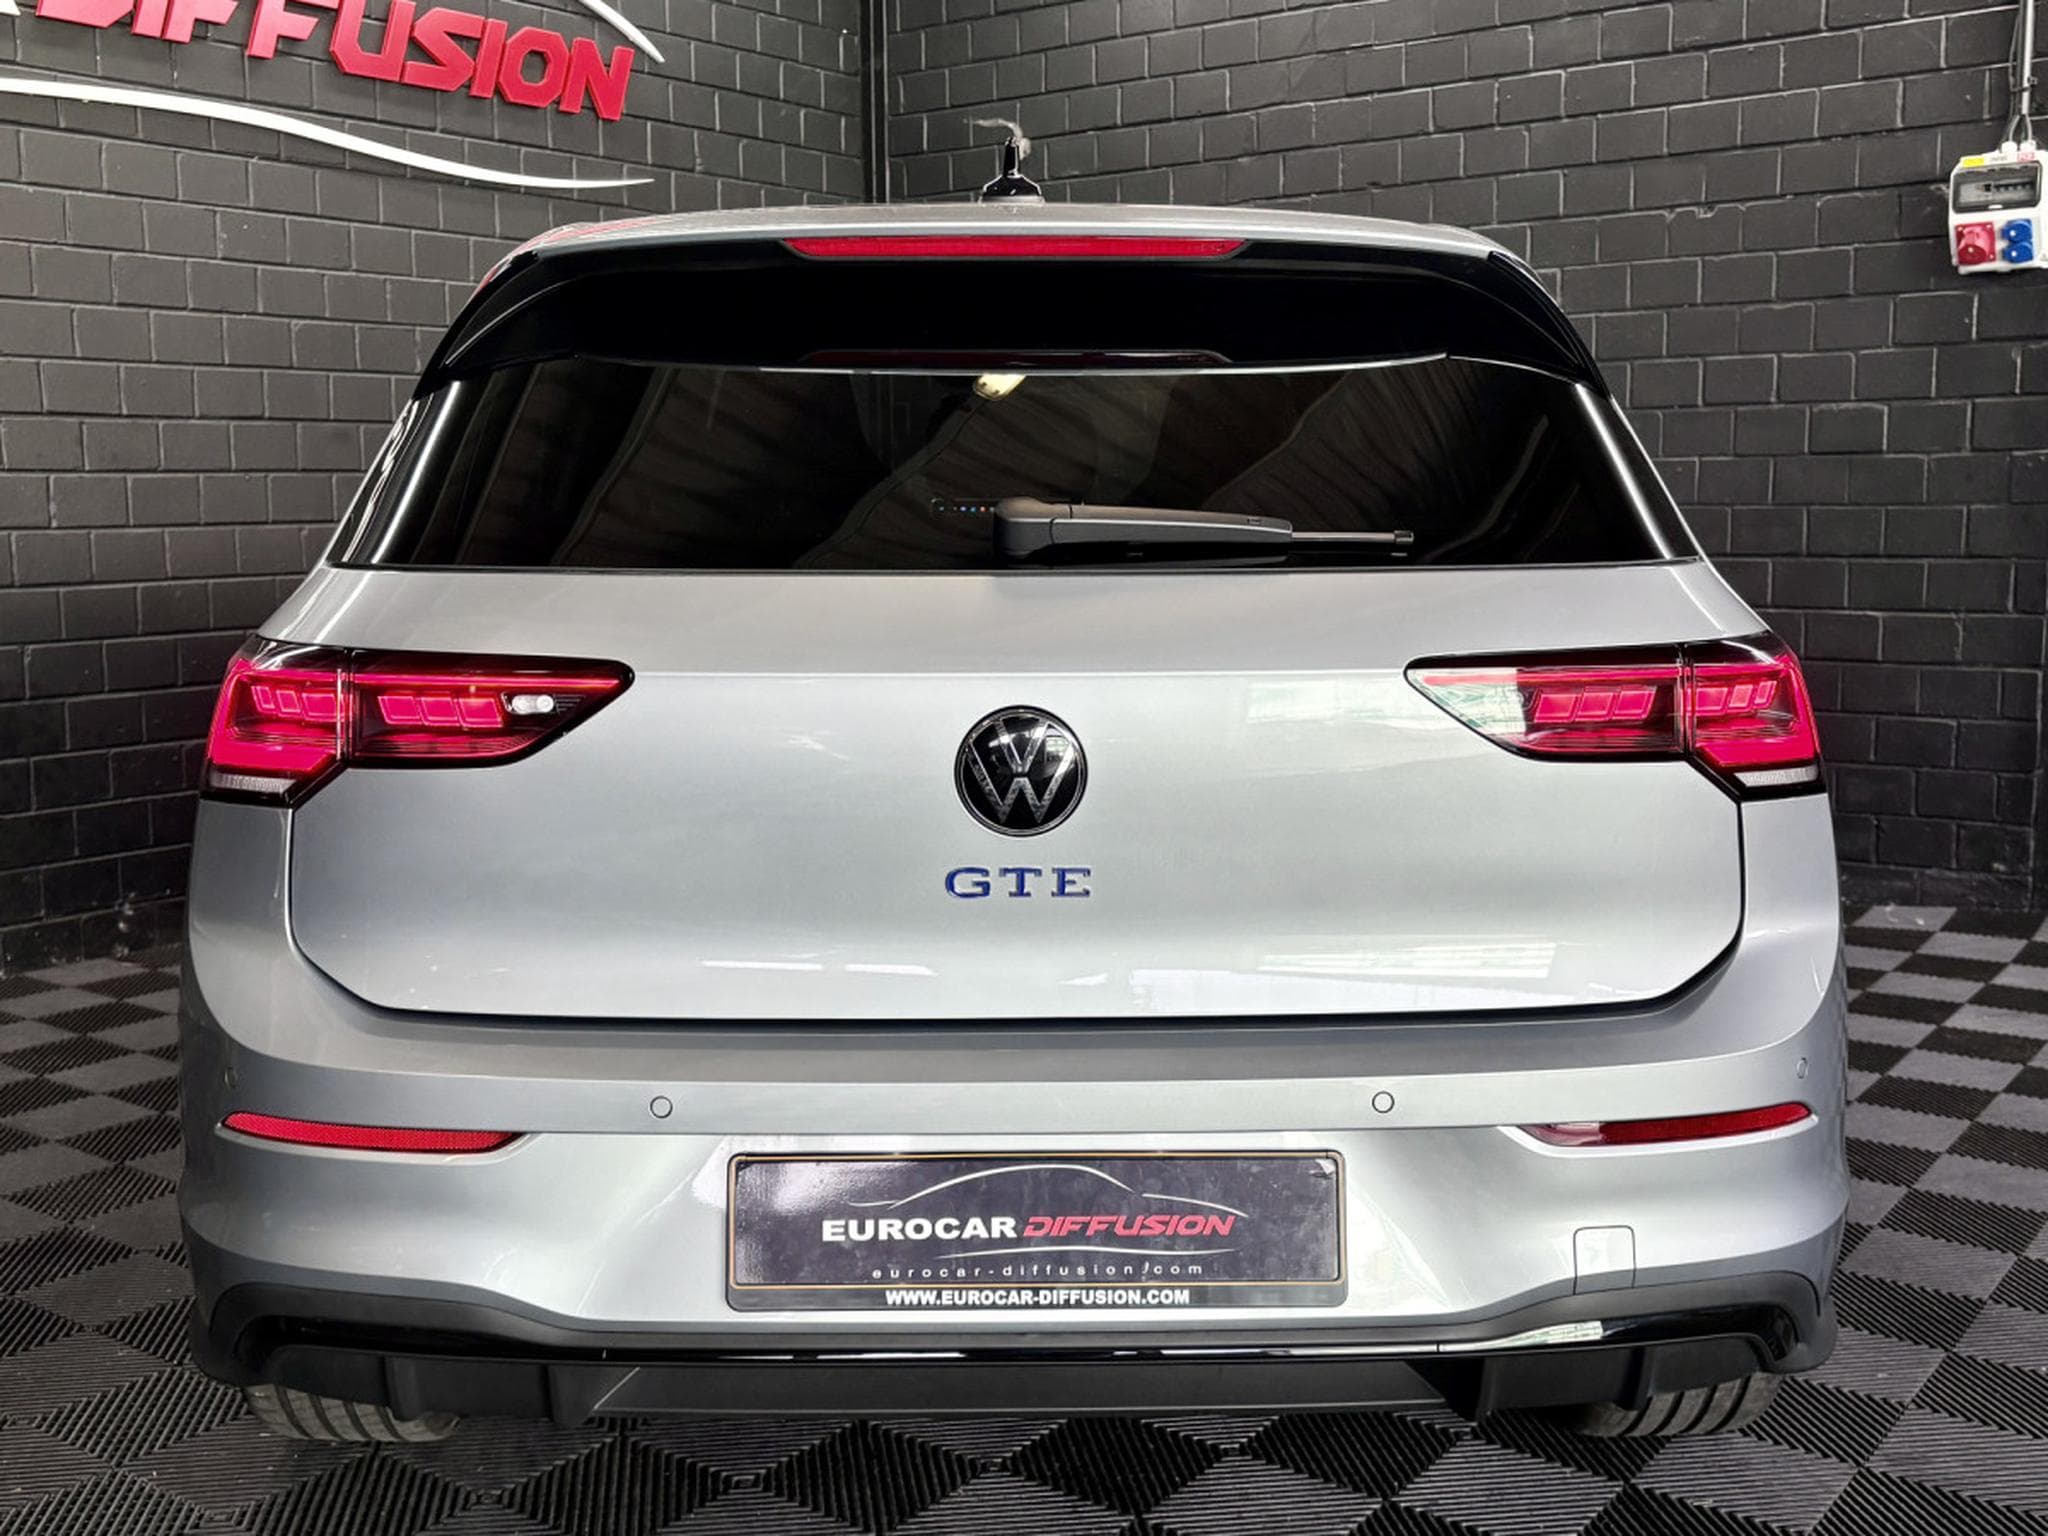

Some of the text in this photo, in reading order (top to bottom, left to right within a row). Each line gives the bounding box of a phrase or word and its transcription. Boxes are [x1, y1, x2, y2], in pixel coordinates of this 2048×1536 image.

[36, 0, 634, 121] FFUSION
[945, 867, 1091, 898] GTE
[822, 1215, 1236, 1242] EUROCAR DIFFUSION
[885, 1289, 1190, 1305] WWW.EUROCAR-DIFFUSION.COM
